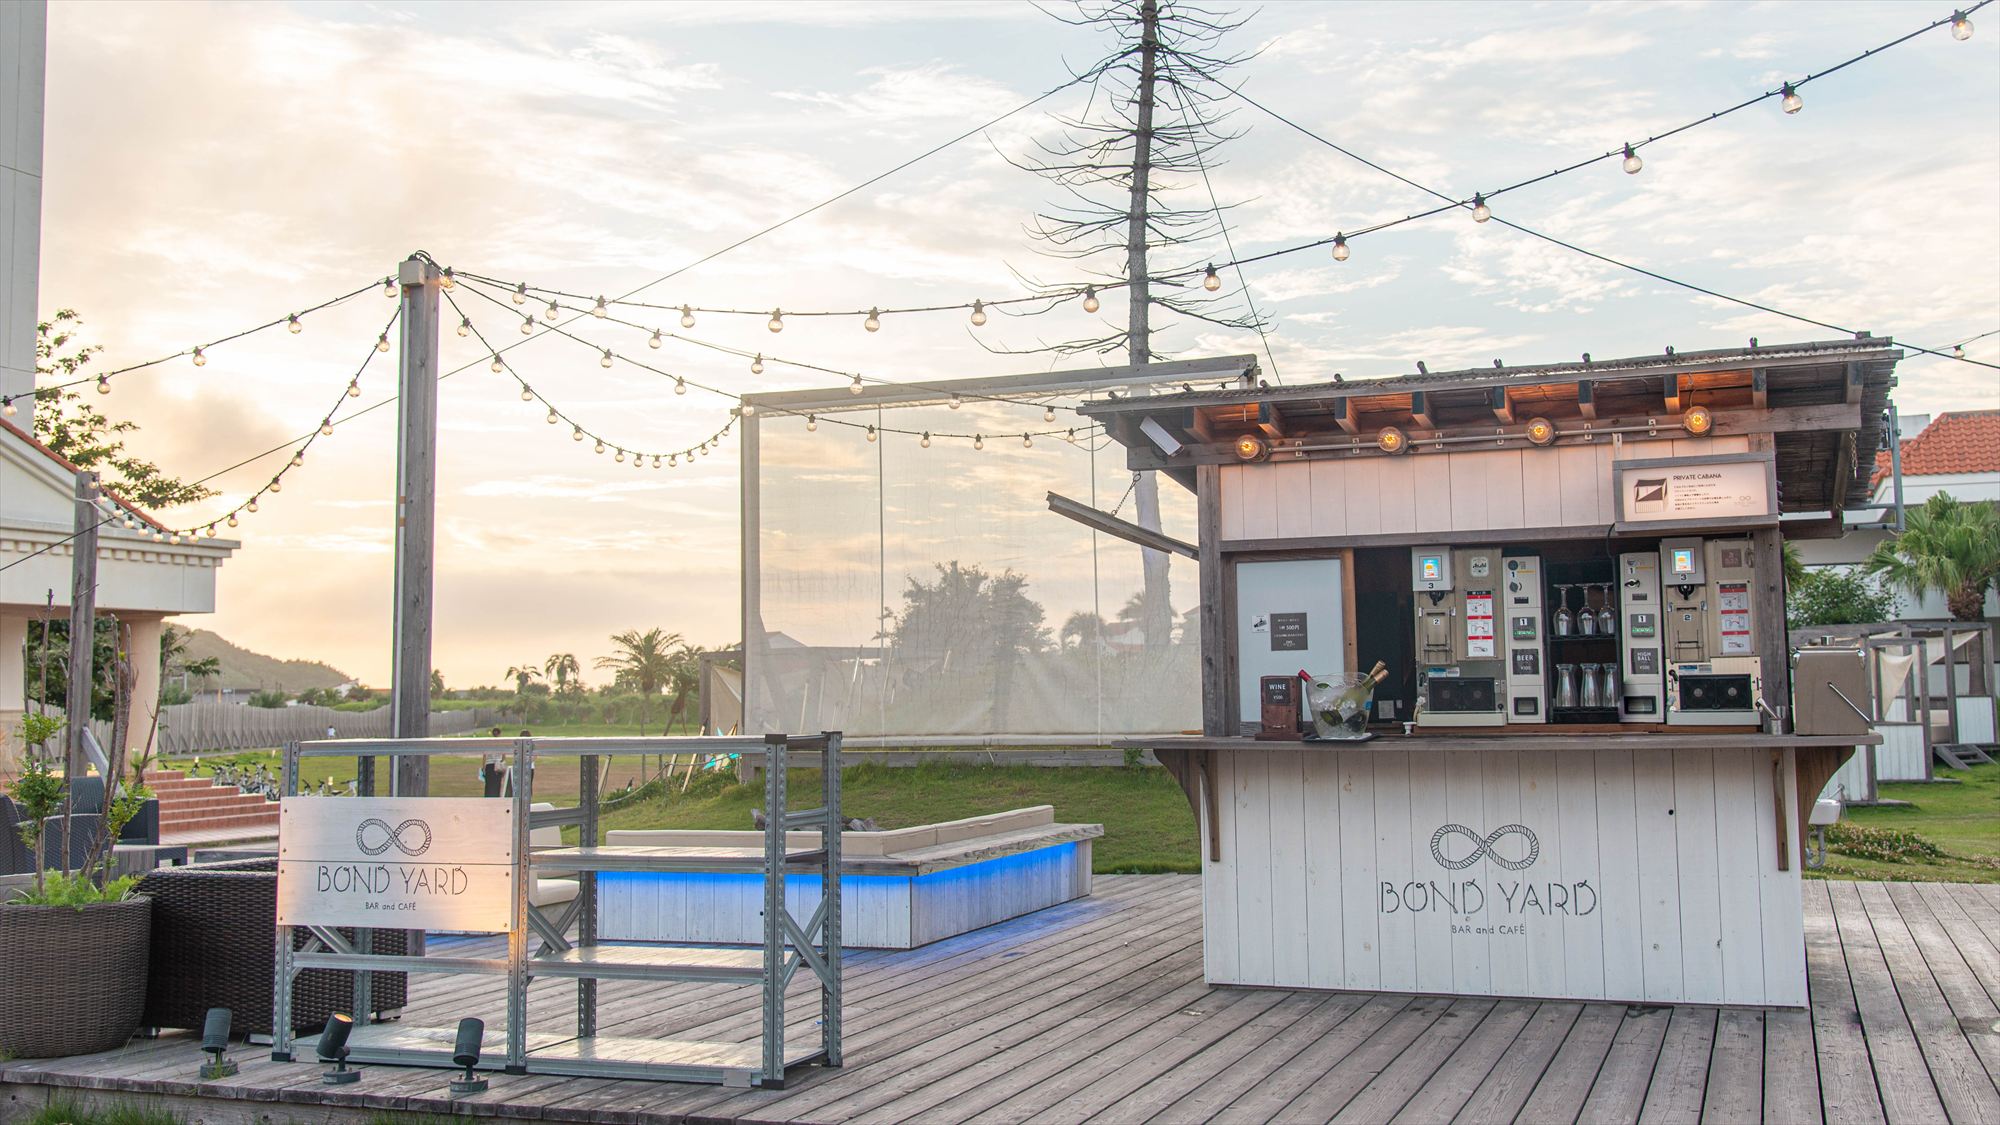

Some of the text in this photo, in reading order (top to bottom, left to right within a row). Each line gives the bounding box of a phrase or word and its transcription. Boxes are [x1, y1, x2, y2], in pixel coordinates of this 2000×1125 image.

[318, 864, 468, 896] BOND YARD
[365, 902, 379, 910] BAR
[382, 902, 395, 911] and
[1380, 878, 1598, 916] BOND YARD
[1450, 923, 1525, 935] BAR and CAFÉ
